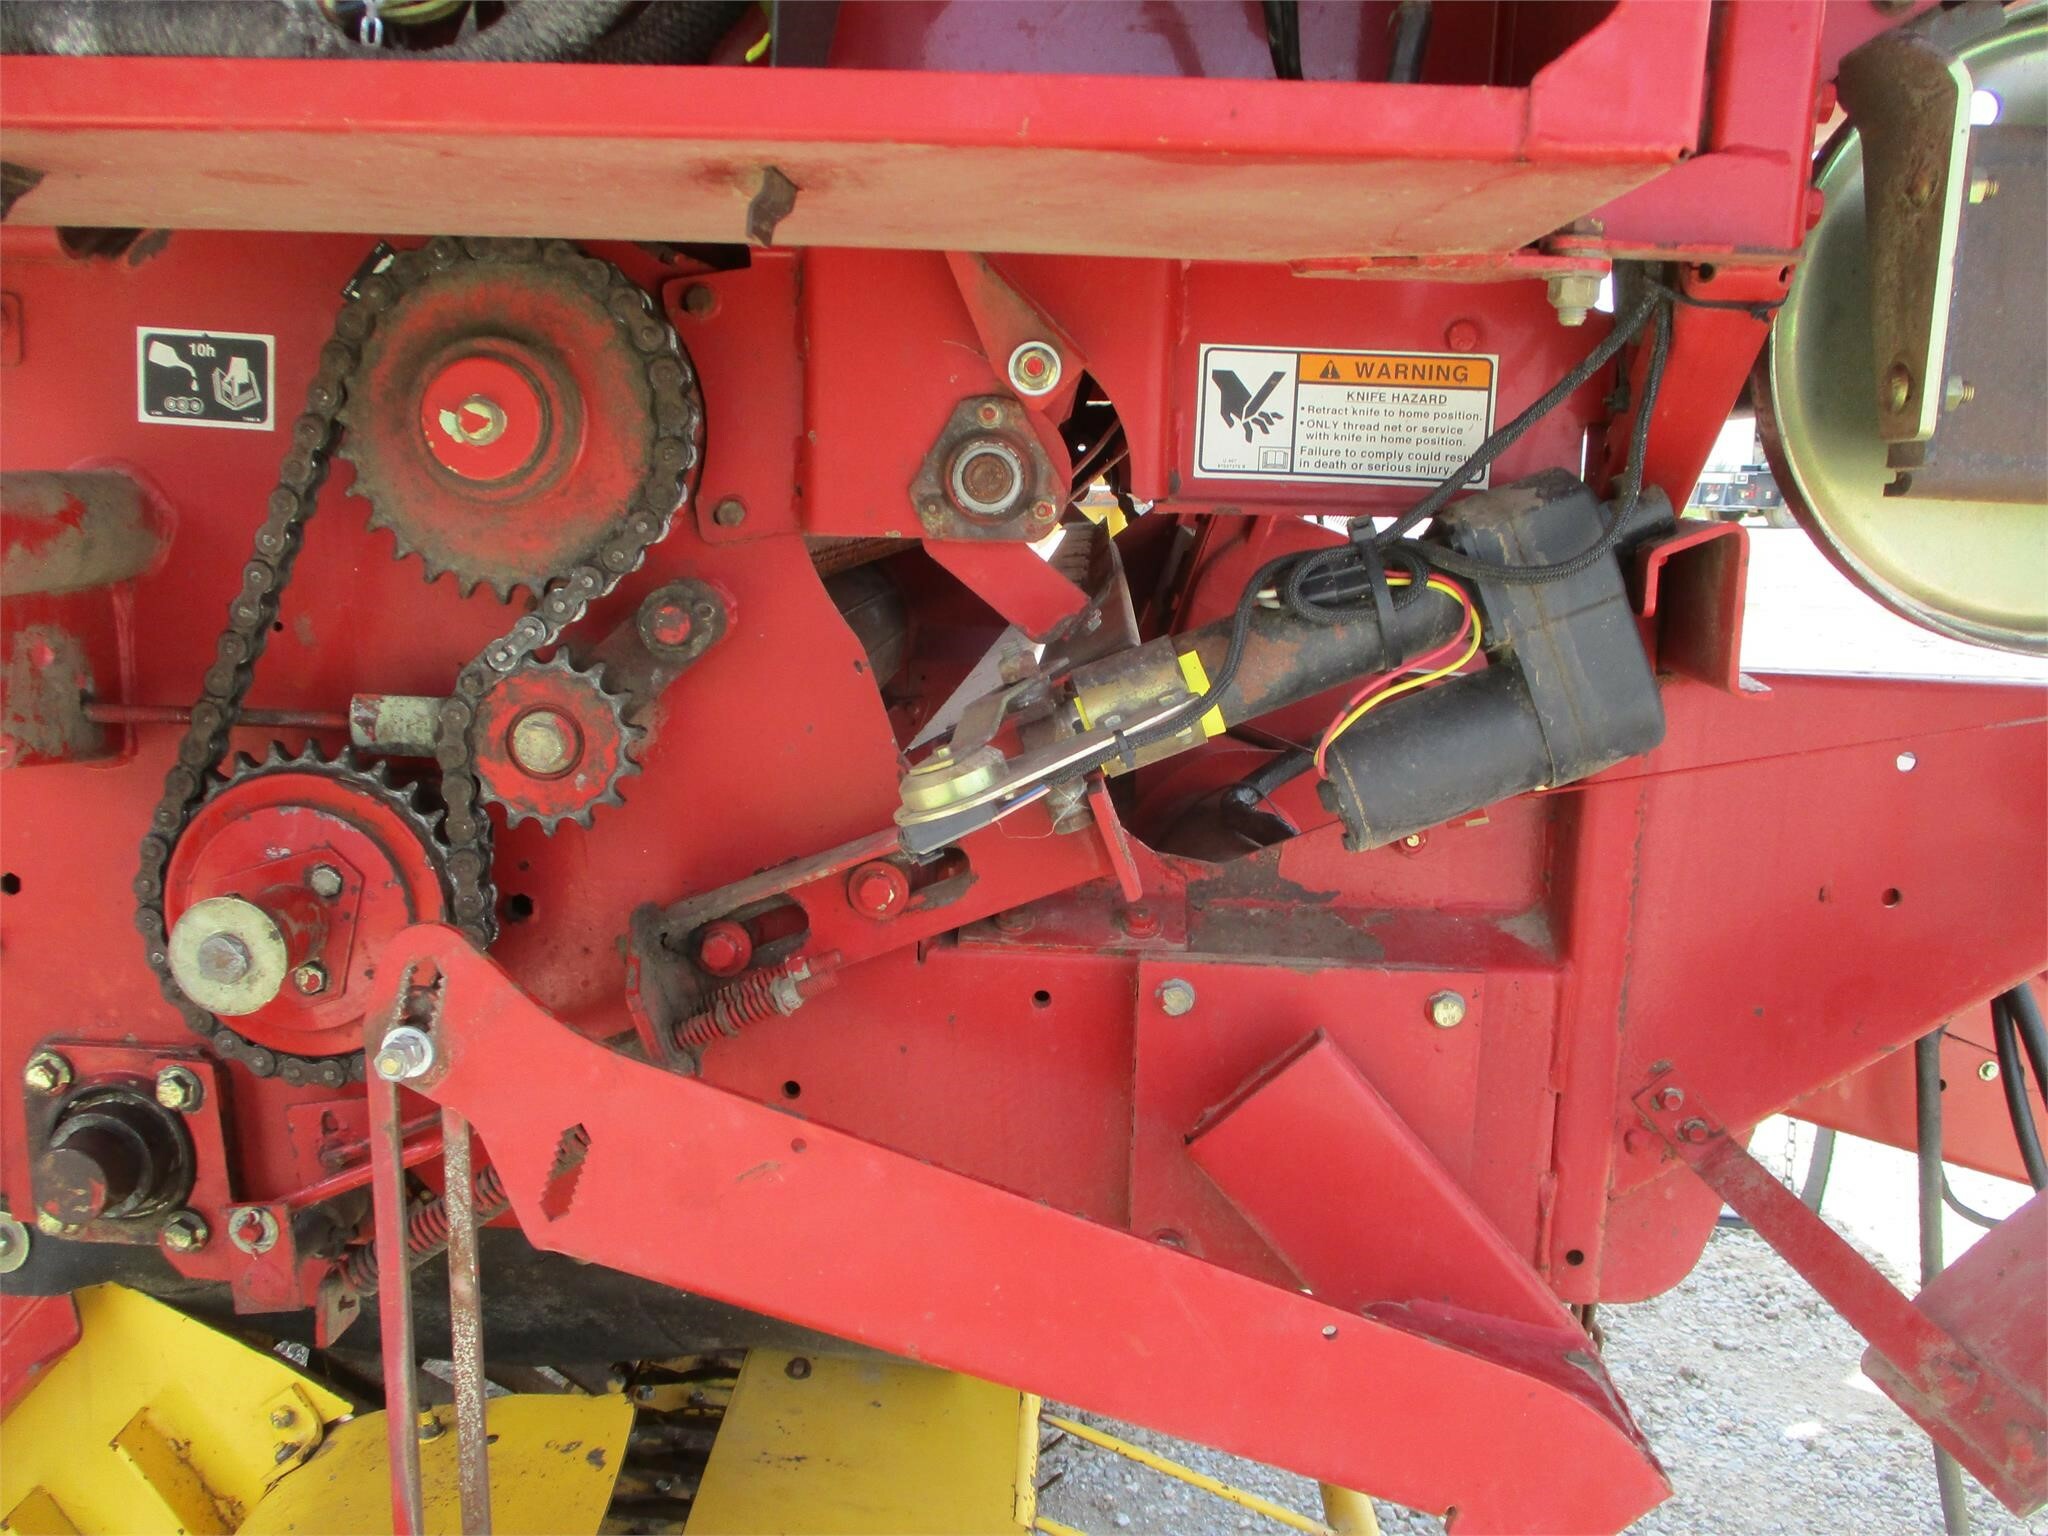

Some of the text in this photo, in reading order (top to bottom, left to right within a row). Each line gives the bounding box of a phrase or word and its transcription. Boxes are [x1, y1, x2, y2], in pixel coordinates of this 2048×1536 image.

[189, 343, 216, 358] 10h
[1355, 361, 1469, 382] WARNING
[1346, 391, 1448, 405] KNIFE HAZARD
[1307, 405, 1482, 423] Retract knife to home position.
[1306, 420, 1464, 435] ONLY thread net or service
[1305, 432, 1467, 447] with knife in home position.
[1300, 446, 1470, 462] Failure to comply could resu
[1299, 459, 1310, 468] in
[1314, 459, 1347, 470] death
[1351, 462, 1364, 471] or
[1367, 462, 1412, 473] serious
